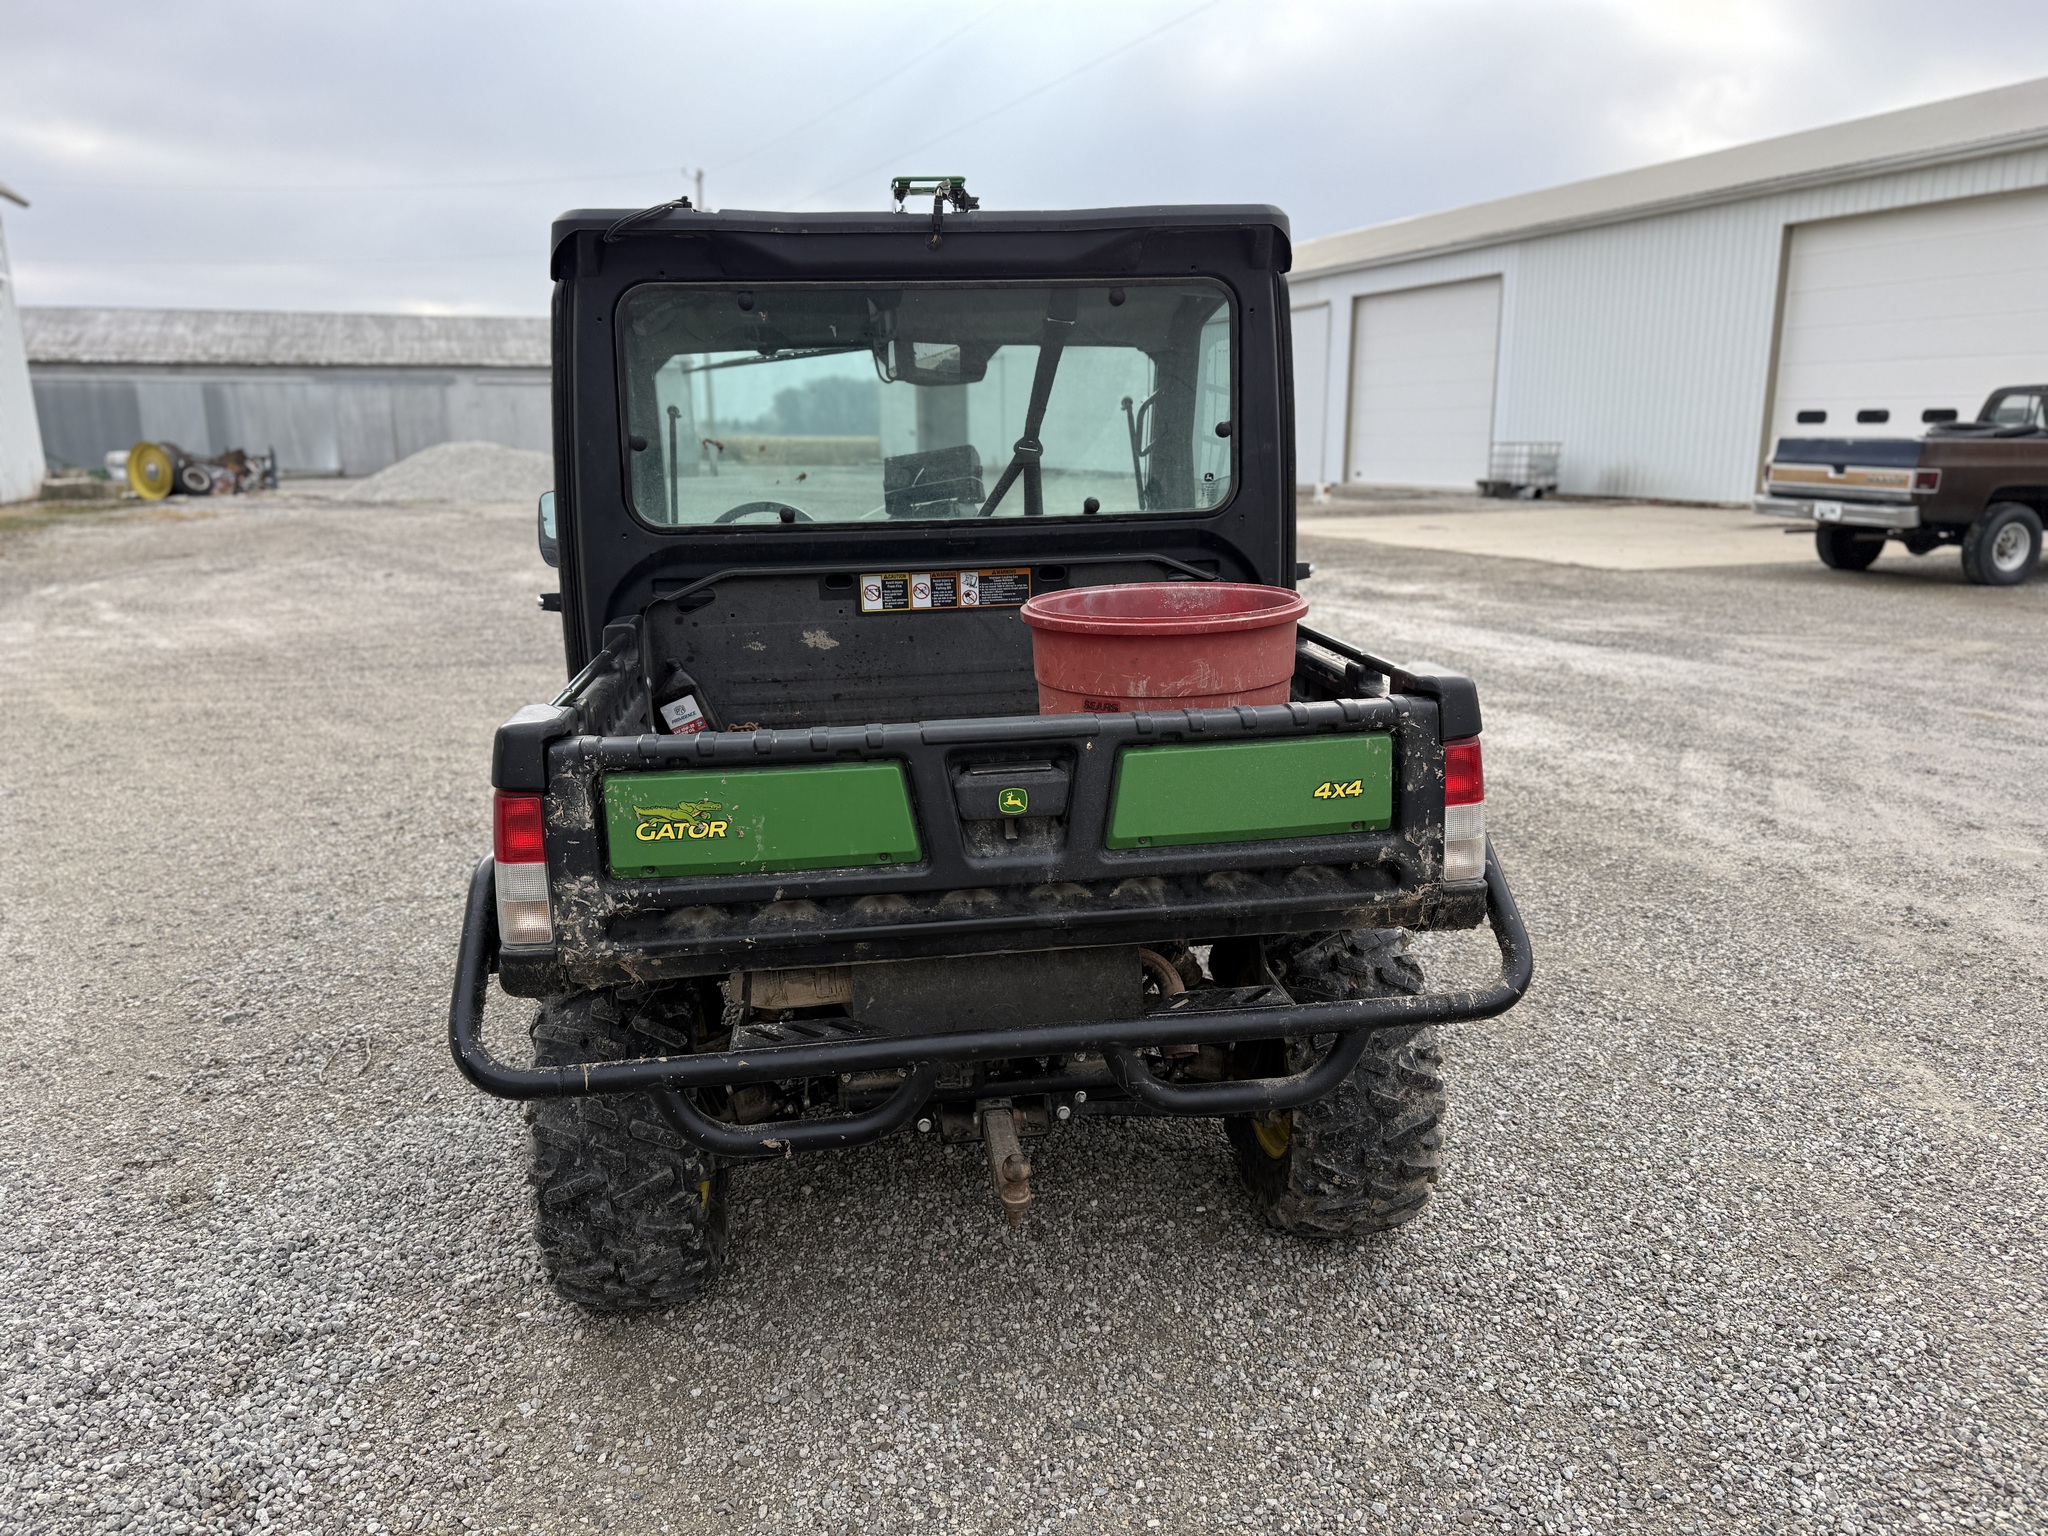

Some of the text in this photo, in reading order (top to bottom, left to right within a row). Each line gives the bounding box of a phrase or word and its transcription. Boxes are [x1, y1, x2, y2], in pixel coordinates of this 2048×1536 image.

[1083, 700, 1119, 713] SEARS
[1313, 779, 1364, 800] 4x4
[634, 819, 728, 842] GATOR
